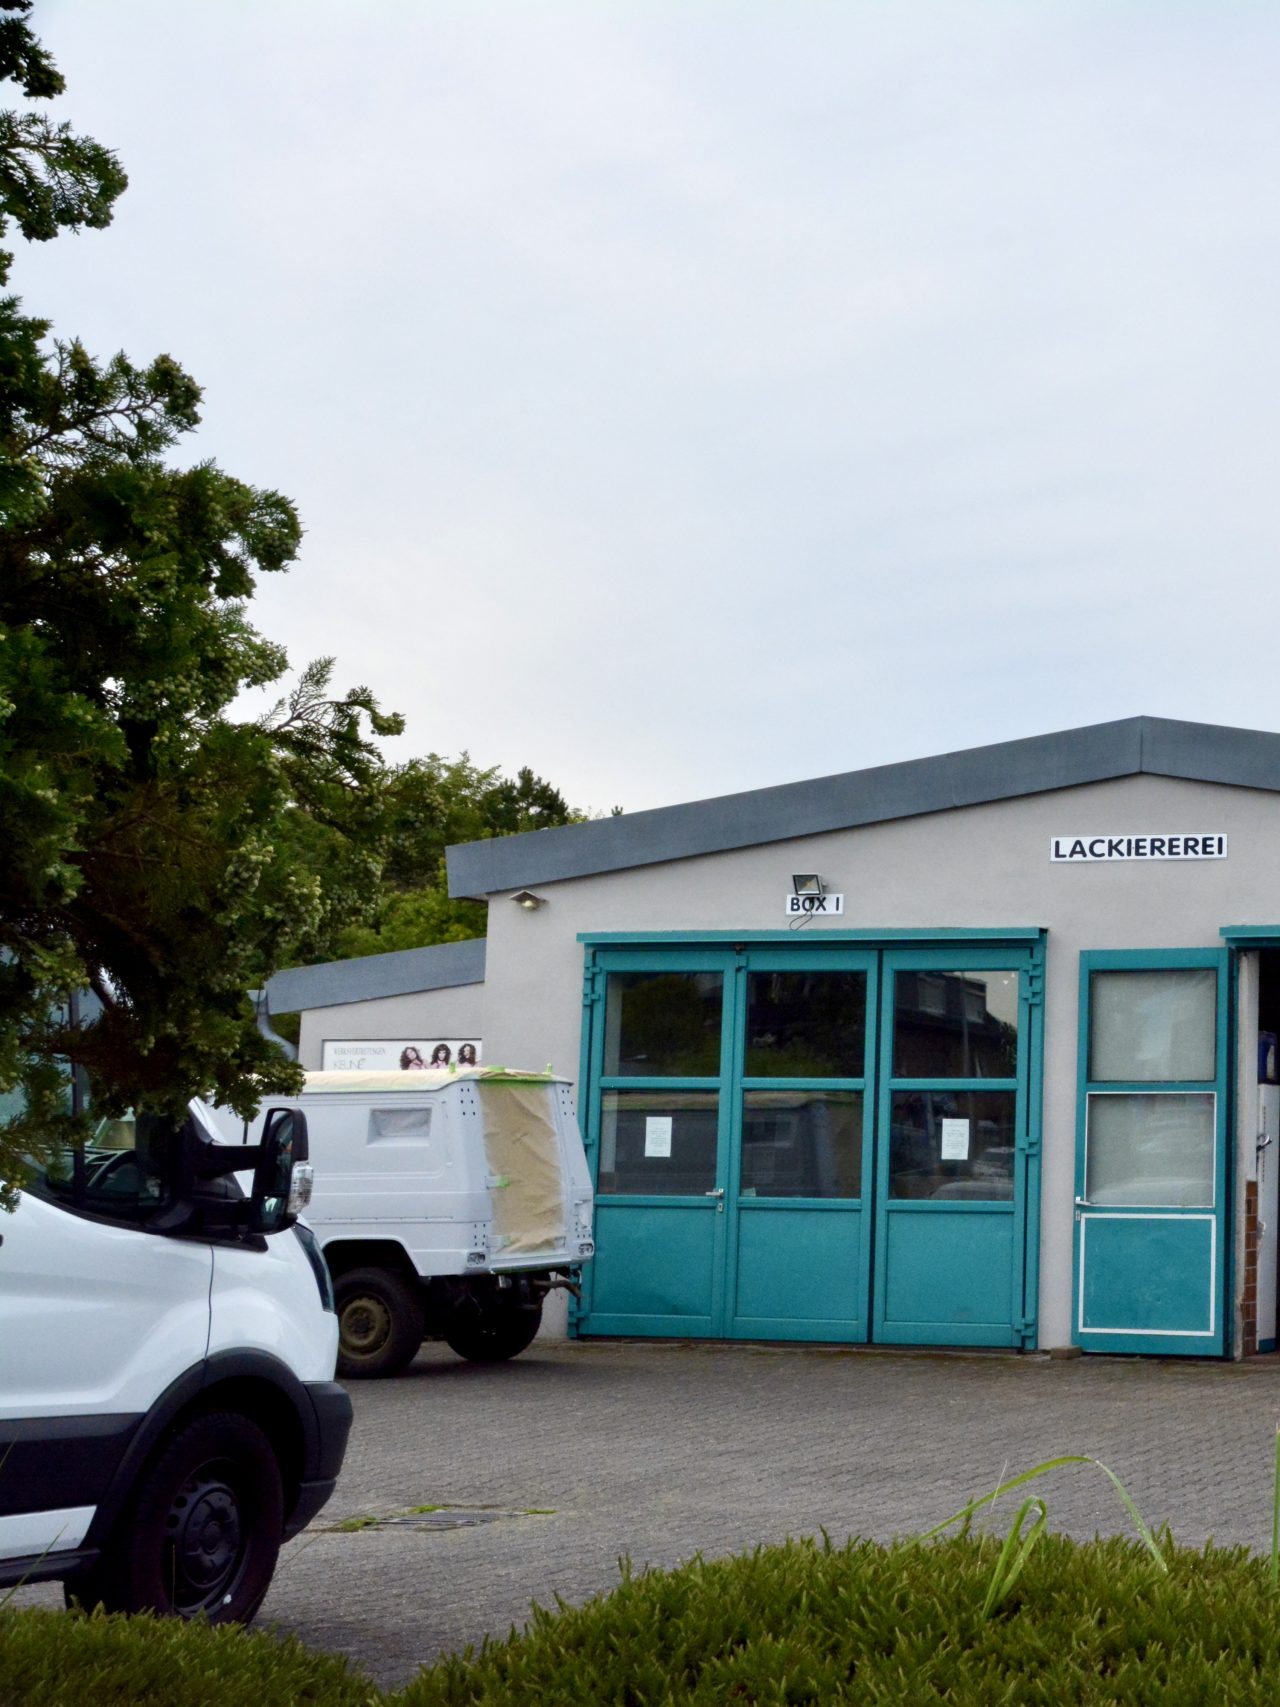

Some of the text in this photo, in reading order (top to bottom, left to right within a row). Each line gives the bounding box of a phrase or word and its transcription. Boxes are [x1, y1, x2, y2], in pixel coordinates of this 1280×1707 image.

[1054, 836, 1223, 859] LACKIEREREI
[790, 896, 840, 912] BOX I
